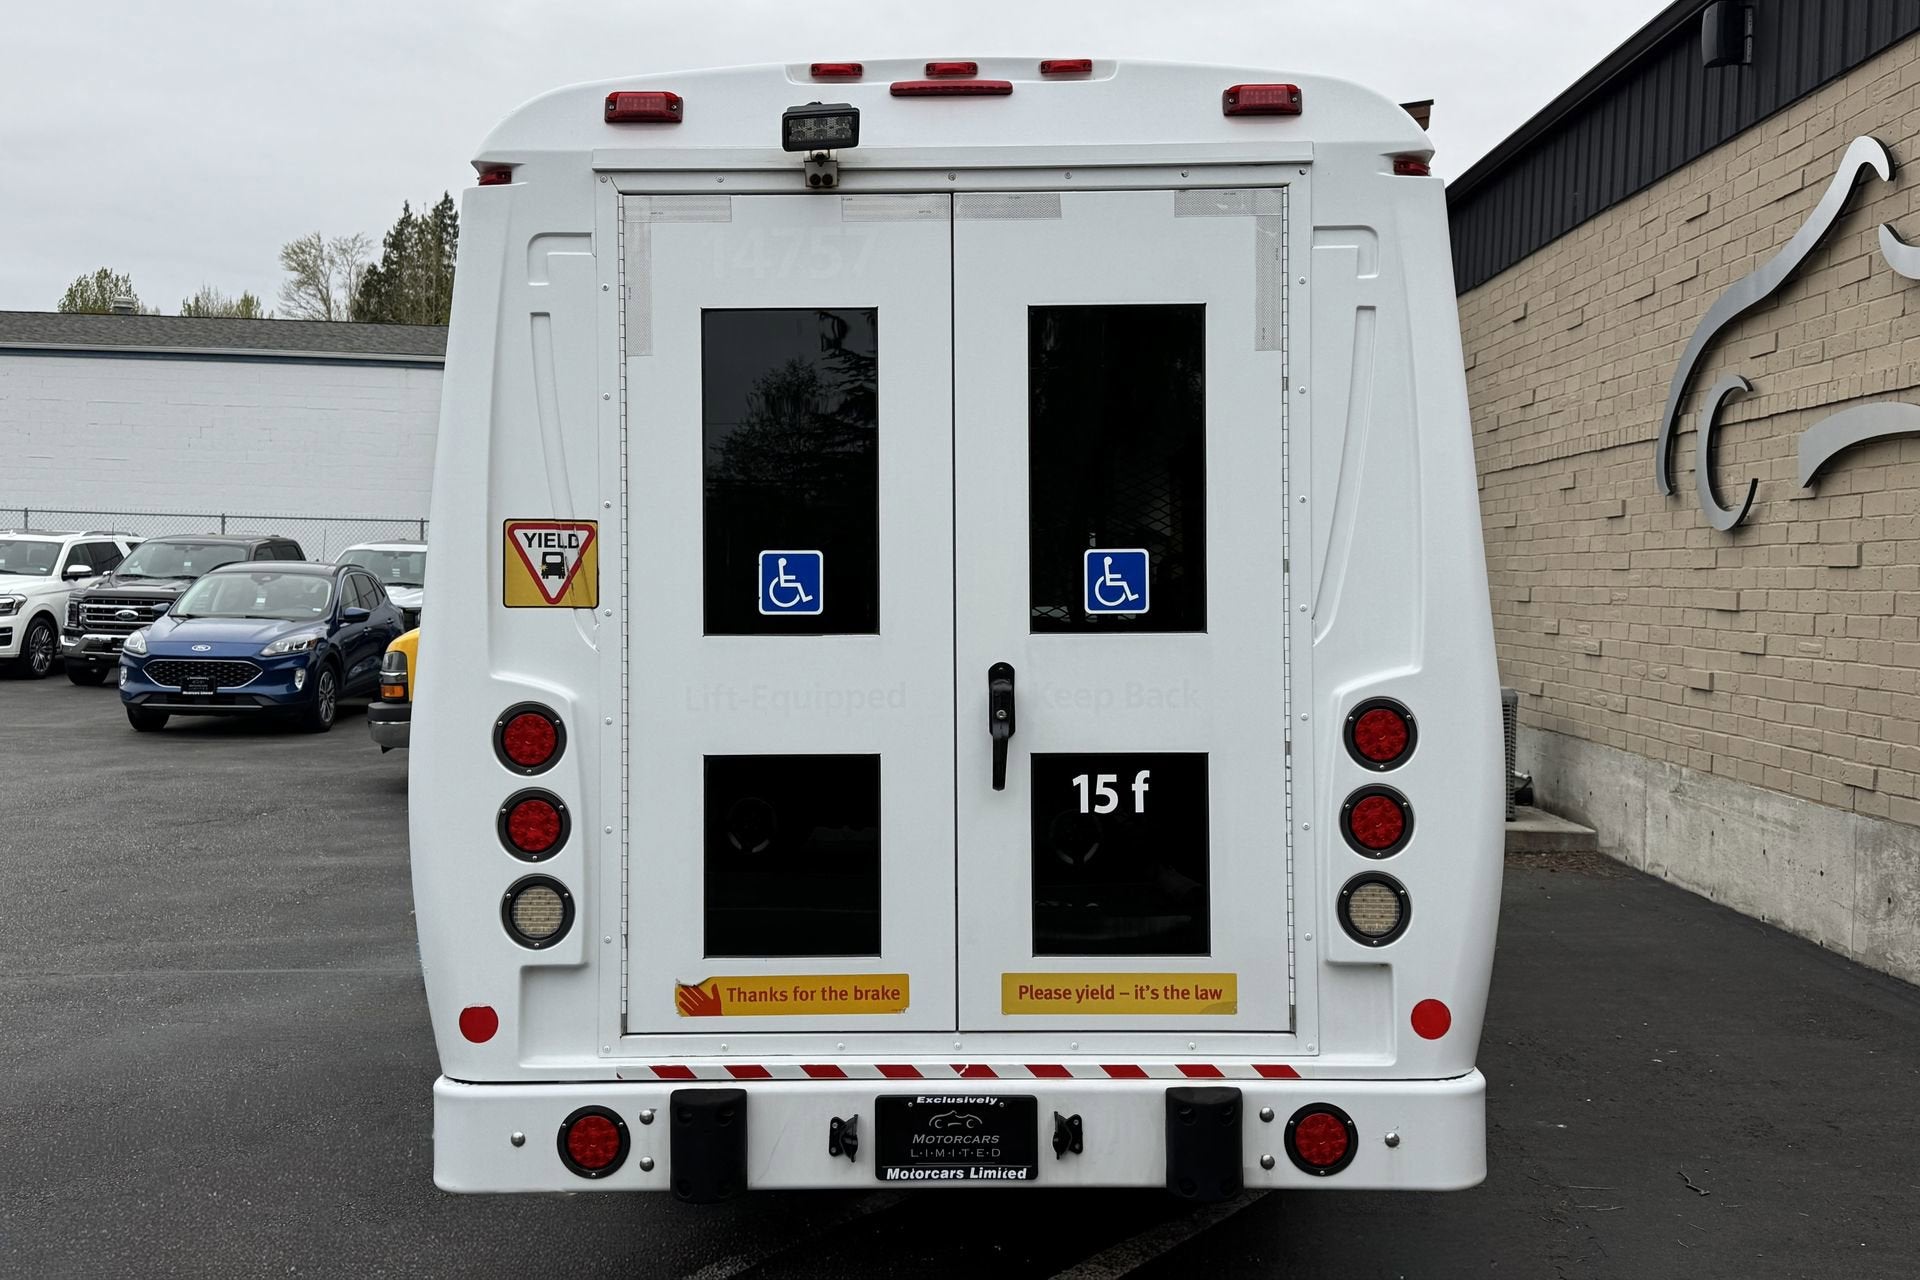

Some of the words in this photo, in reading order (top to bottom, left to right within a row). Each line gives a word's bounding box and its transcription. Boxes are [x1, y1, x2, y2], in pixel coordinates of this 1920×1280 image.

[703, 227, 878, 279] 14757
[523, 532, 580, 549] YIELD
[685, 681, 906, 716] Lift-Equipped
[1035, 681, 1113, 715] Keep
[1125, 679, 1201, 708] Back
[1072, 774, 1119, 814] 15
[1131, 770, 1150, 813] f
[726, 987, 788, 1003] Thanks
[793, 986, 817, 1001] for
[821, 985, 848, 1001] the
[853, 985, 901, 1001] brake
[1018, 984, 1072, 1000] Please
[1075, 984, 1115, 1003] yield
[1134, 984, 1160, 1000] it’s
[1163, 984, 1191, 1000] the
[1194, 984, 1223, 1000] law
[916, 1096, 998, 1106] Exclusively
[912, 1134, 1000, 1144] MOTORCARS
[886, 1167, 964, 1180] Motorcars
[969, 1167, 1027, 1179] Limited
